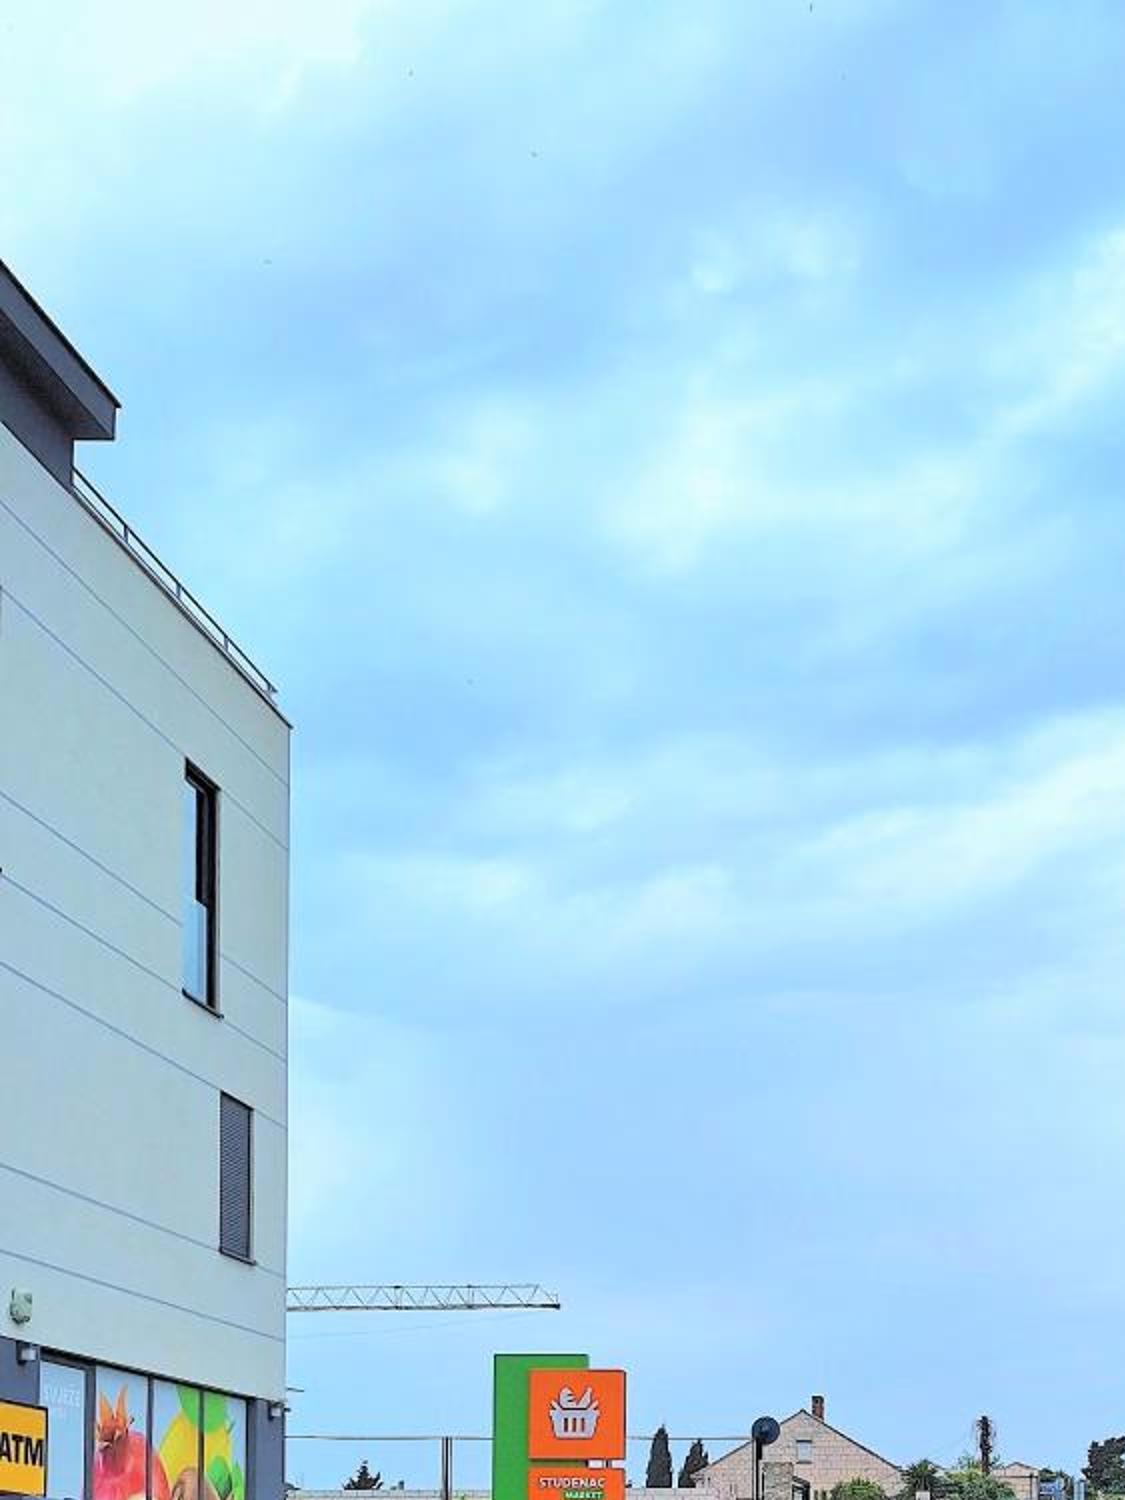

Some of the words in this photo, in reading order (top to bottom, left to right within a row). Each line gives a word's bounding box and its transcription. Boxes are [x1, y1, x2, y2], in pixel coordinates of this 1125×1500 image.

[0, 1431, 44, 1467] ATM
[539, 1477, 606, 1489] STUDENAC
[564, 1491, 603, 1500] MARKET
